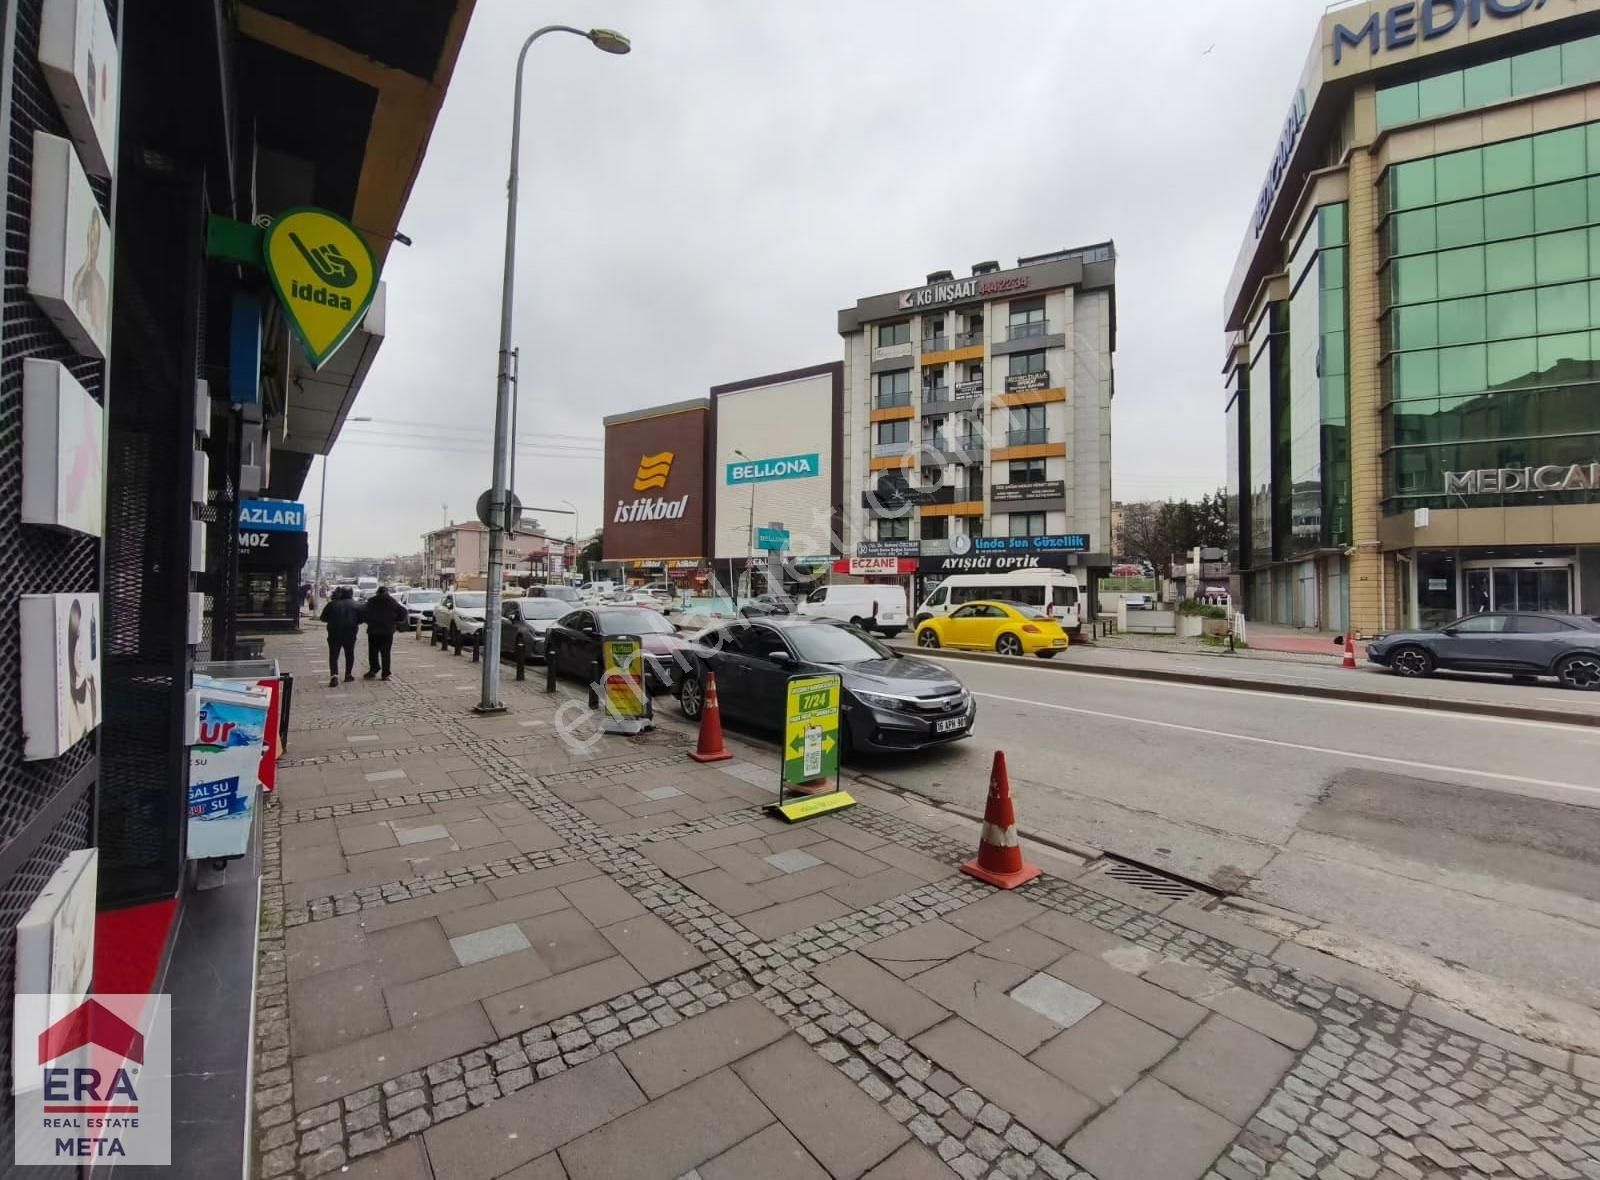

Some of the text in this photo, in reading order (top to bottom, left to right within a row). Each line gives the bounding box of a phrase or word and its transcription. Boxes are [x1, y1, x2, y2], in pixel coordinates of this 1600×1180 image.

[291, 280, 352, 311] iddaa
[917, 289, 933, 305] KG
[935, 281, 978, 302] İNŞAAT
[733, 458, 811, 480] BELLONA
[614, 495, 689, 523] istikbal
[976, 540, 1005, 550] Linda
[1034, 536, 1084, 548] Güzellik
[852, 559, 895, 569] ECZANE
[942, 555, 1040, 571] AYIŞIĞI OPTİK
[803, 693, 826, 710] 7/24
[212, 782, 229, 793] SU
[211, 799, 227, 810] SU
